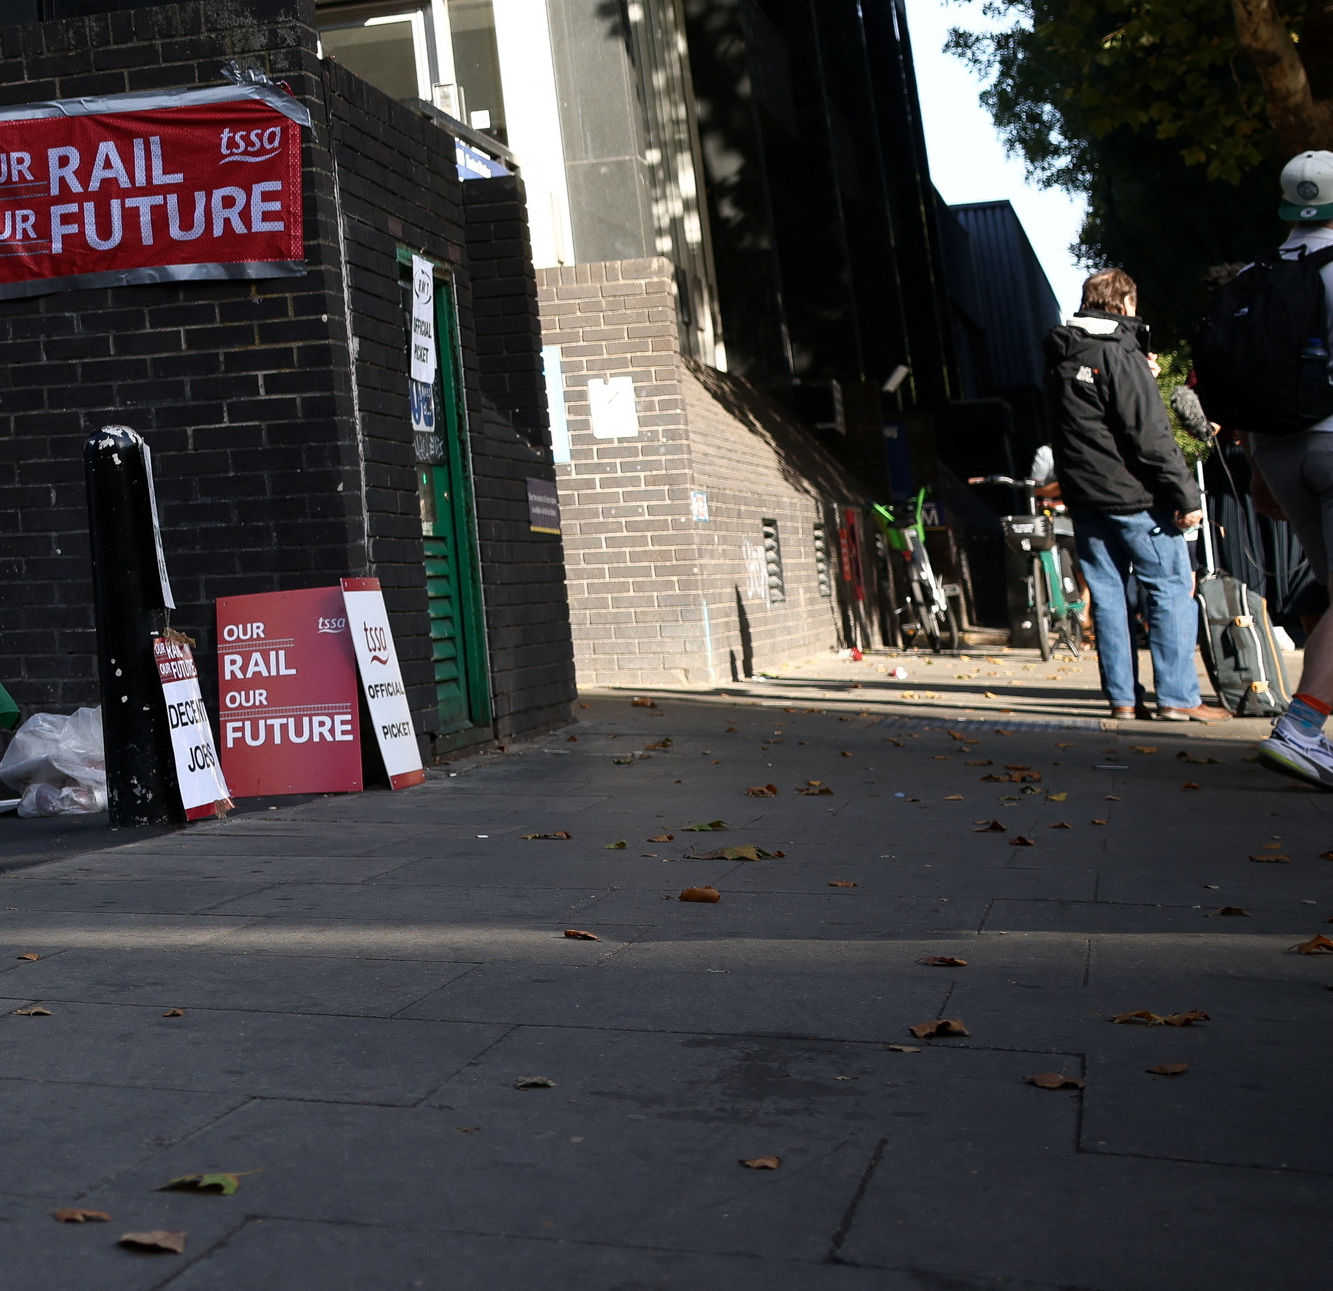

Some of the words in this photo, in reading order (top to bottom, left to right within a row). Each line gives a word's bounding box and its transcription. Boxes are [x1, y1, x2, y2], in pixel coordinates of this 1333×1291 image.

[220, 126, 282, 156] tssa
[48, 135, 184, 197] RAIL
[50, 180, 285, 254] FUTURE
[413, 316, 432, 338] OFFICIAL
[414, 343, 429, 363] PICKET
[223, 622, 265, 641] OUR
[318, 616, 346, 630] tssa
[364, 621, 388, 653] tssa
[159, 662, 173, 676] OUR
[224, 650, 297, 680] RAIL
[225, 688, 268, 708] OUR
[368, 682, 406, 700] OFFICIAL
[168, 698, 207, 730] DECENT
[226, 714, 354, 749] FUTURE
[382, 721, 411, 740] PICKET
[188, 741, 215, 773] JOBS
